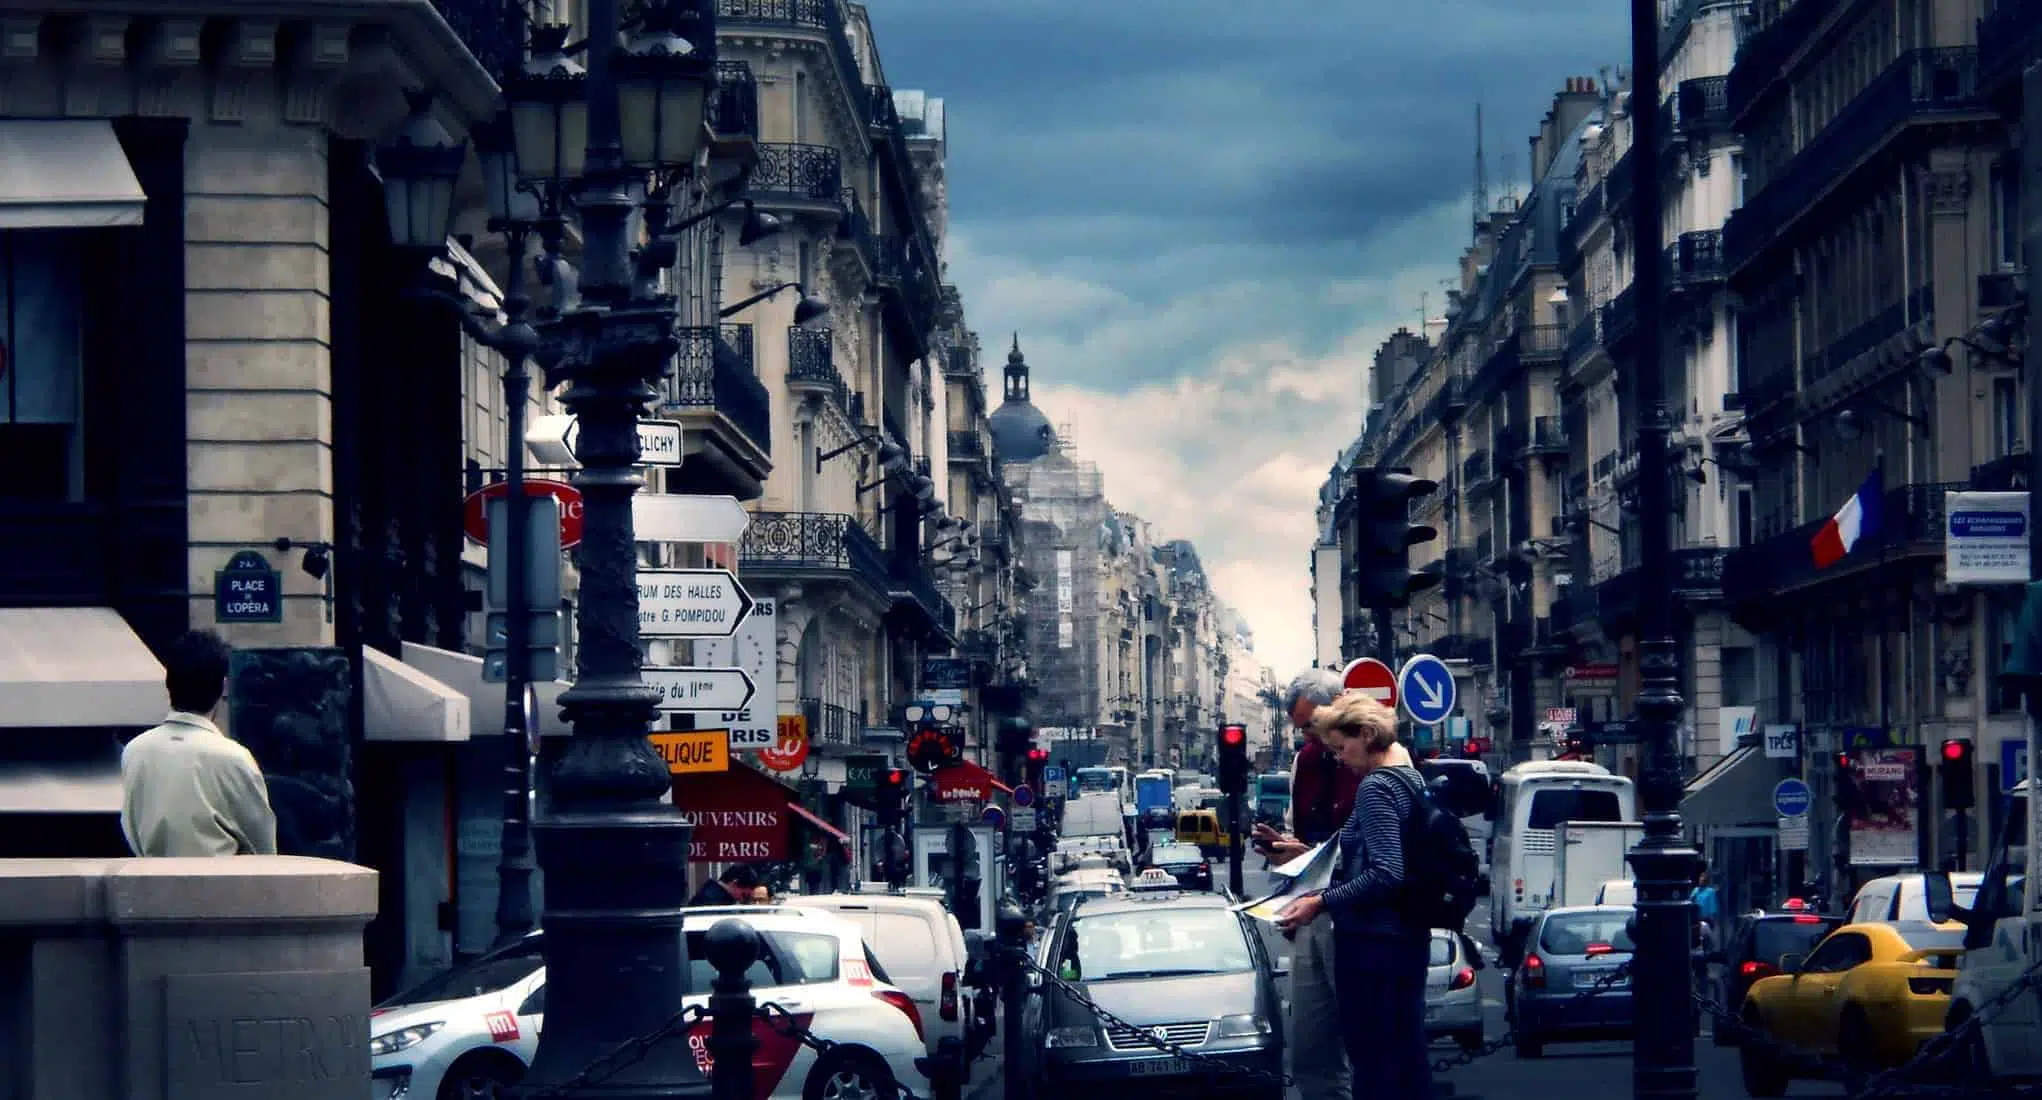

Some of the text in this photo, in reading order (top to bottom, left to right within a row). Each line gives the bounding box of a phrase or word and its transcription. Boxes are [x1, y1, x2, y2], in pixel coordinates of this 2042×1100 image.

[639, 434, 674, 452] CLICHY
[231, 580, 265, 591] PLACE
[664, 585, 682, 599] DES
[688, 585, 722, 599] HALLES
[675, 608, 726, 623] POMPIDOU
[670, 681, 684, 699] du
[721, 708, 751, 722] DE
[732, 729, 771, 743] RIS
[719, 842, 769, 857] PARIS
